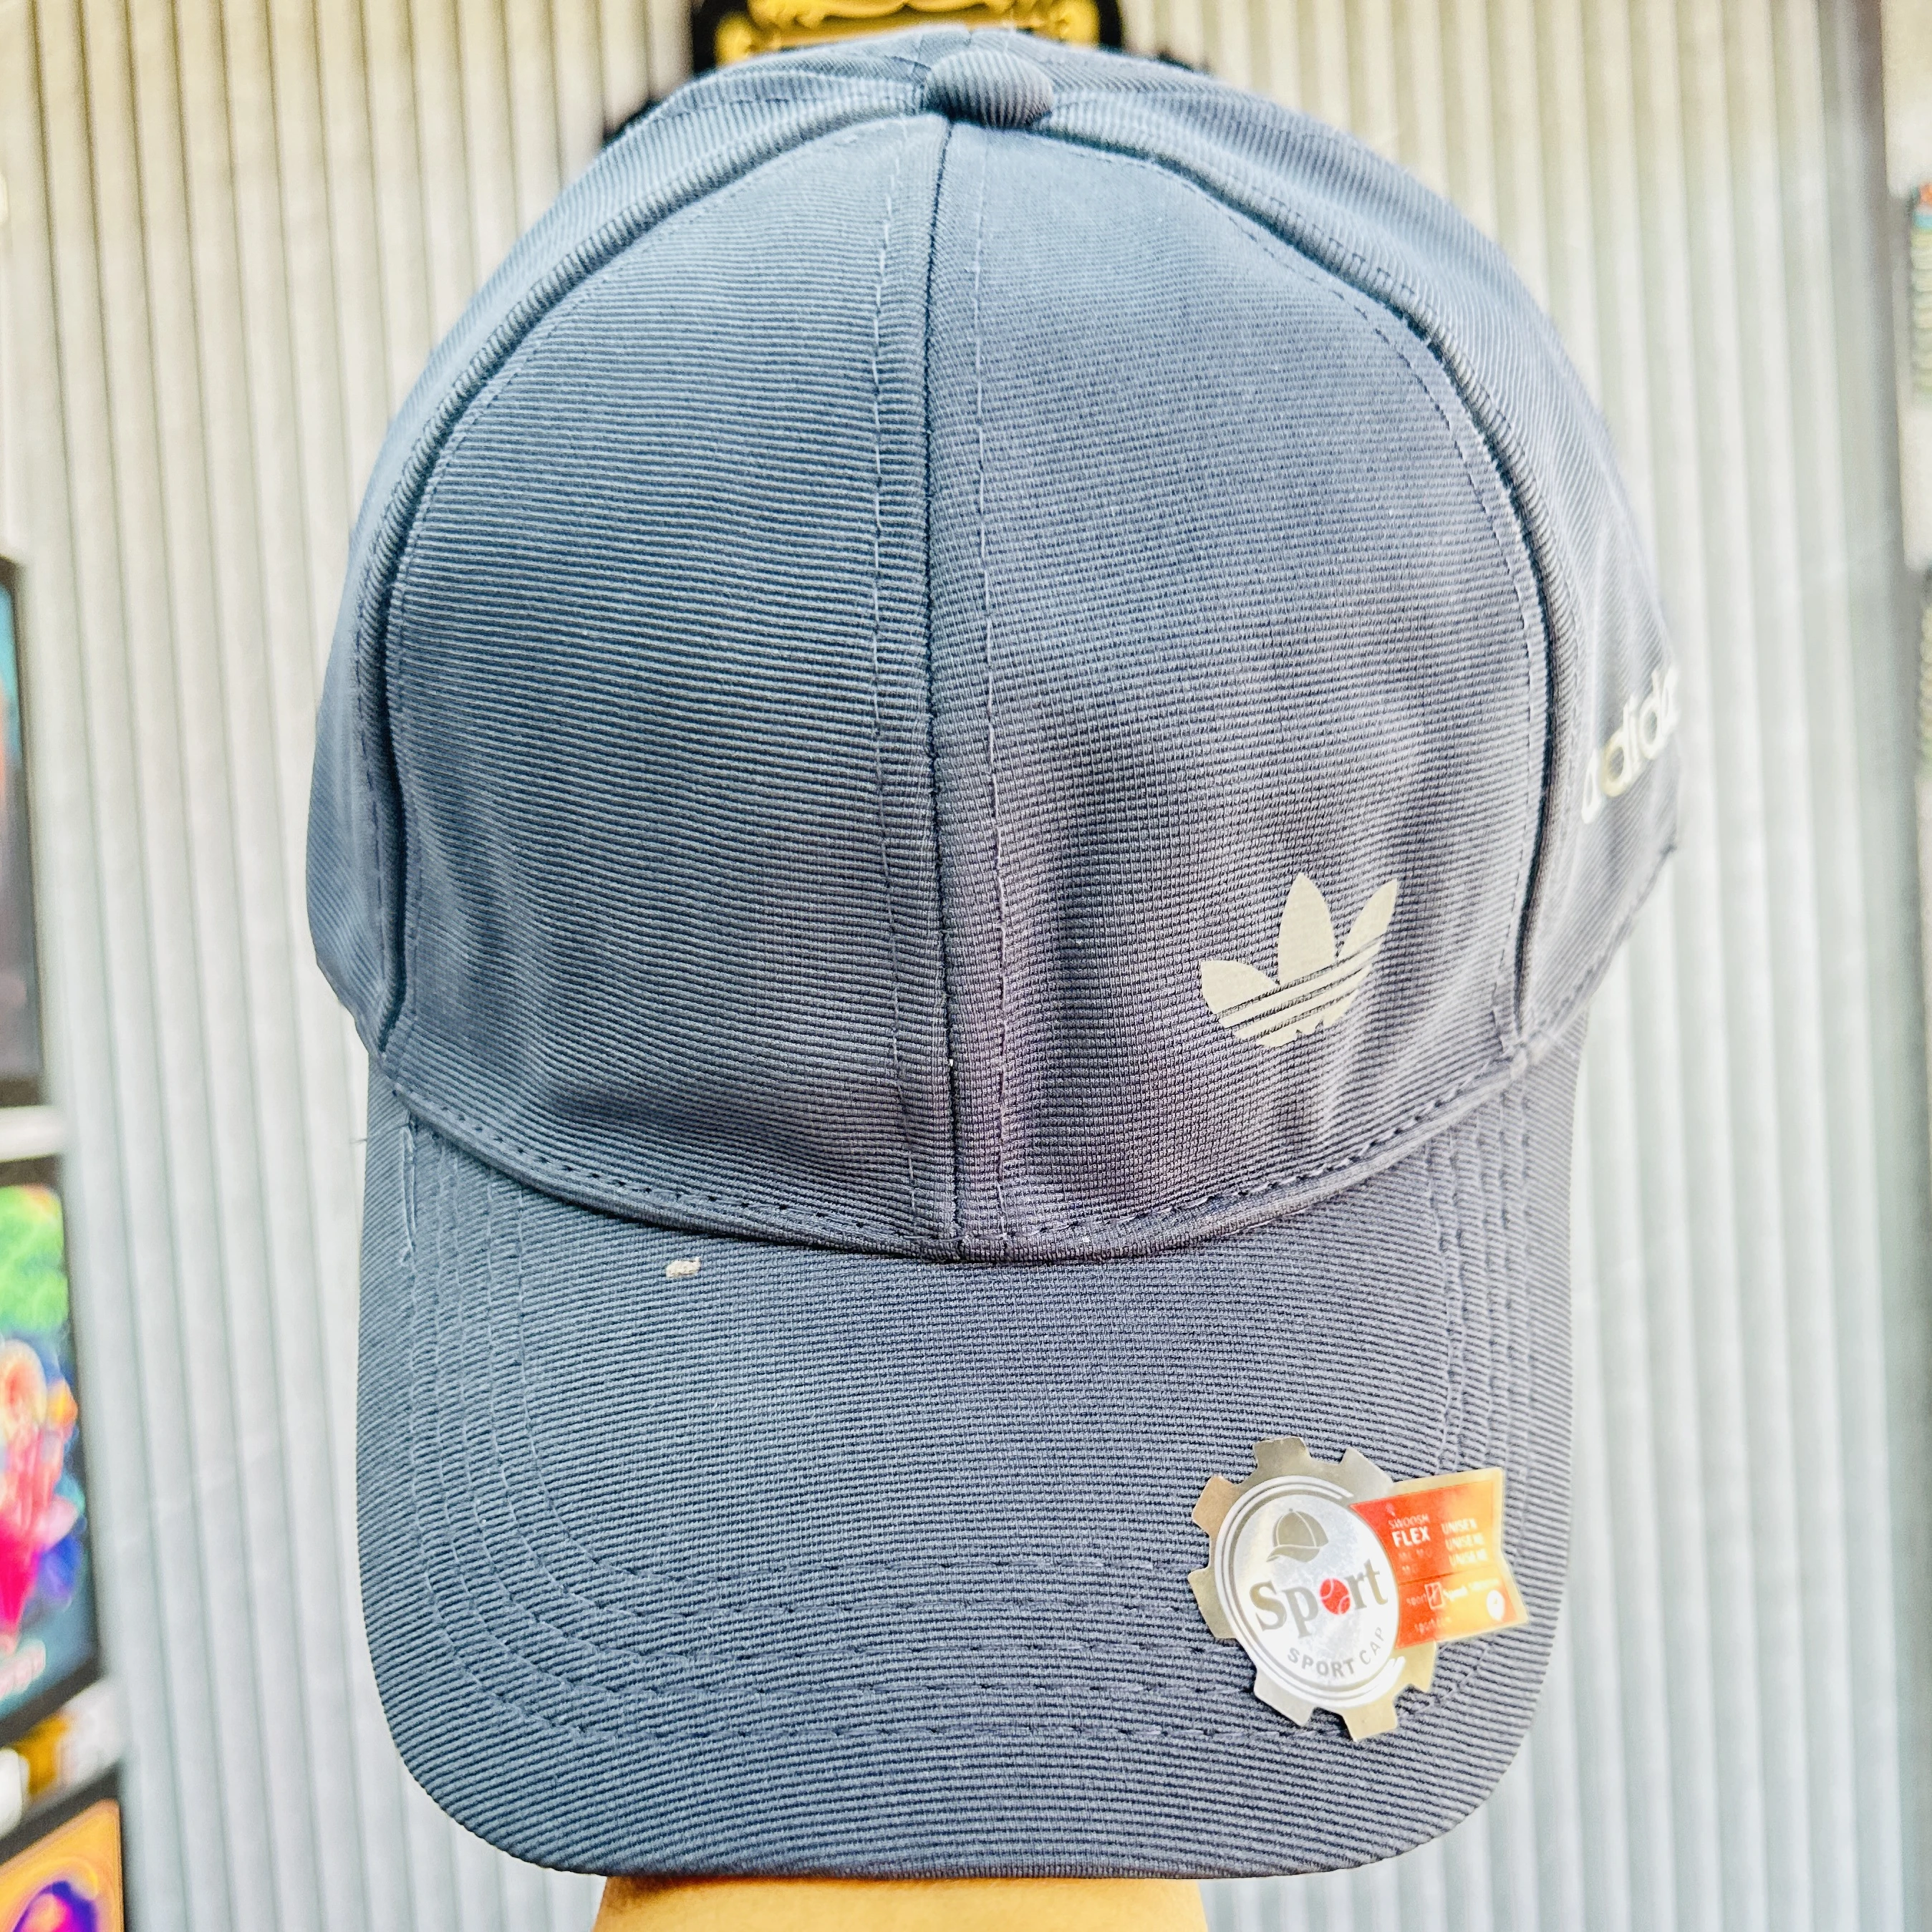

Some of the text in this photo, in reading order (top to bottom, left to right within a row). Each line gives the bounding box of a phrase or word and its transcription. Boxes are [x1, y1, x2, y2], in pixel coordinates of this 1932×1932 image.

[1391, 1526, 1431, 1547] FLEX
[1250, 1558, 1388, 1638] Sport
[1287, 1626, 1385, 1678] SPORT CAP
